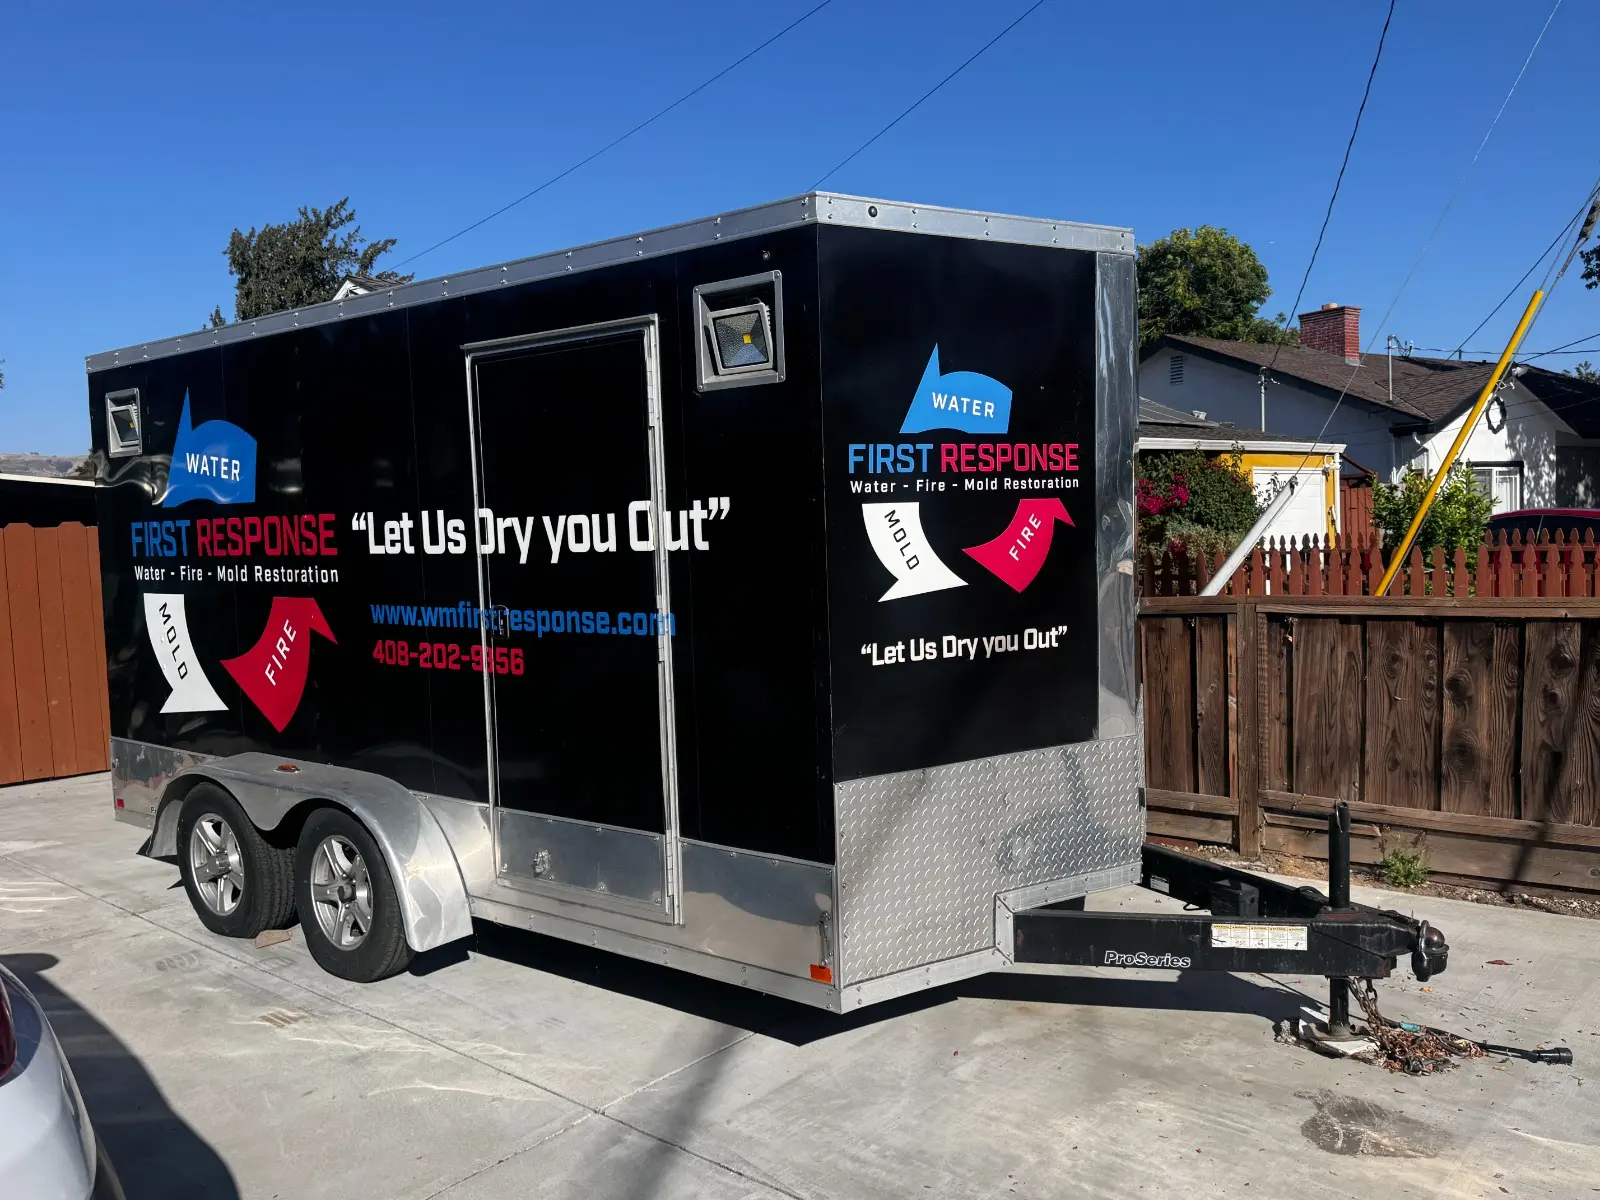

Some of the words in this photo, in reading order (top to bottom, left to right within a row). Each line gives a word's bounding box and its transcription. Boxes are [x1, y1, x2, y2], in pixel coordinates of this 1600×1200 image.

[932, 392, 995, 418] WATER
[186, 452, 241, 482] WATER
[849, 444, 934, 474] FIRST
[941, 443, 1079, 473] RESPONSE
[850, 480, 896, 494] Water
[916, 478, 946, 492] Fire
[964, 477, 998, 491] Mold
[1004, 476, 1079, 490] Restoration
[130, 519, 191, 558] FIRST
[196, 513, 338, 557] RESPONSE
[351, 511, 415, 555] “Let
[421, 509, 467, 555] Us
[476, 507, 535, 565] Dry
[541, 512, 617, 564] you
[627, 496, 731, 552] Out”
[884, 509, 920, 571] MOLD
[1008, 513, 1042, 562] FIRE
[134, 565, 166, 582] Water
[179, 566, 203, 582] Fire
[217, 565, 248, 583] Mold
[254, 565, 339, 584] Restoration
[158, 601, 189, 681] MOLD
[264, 618, 297, 687] FIRE
[860, 641, 906, 666] “Let
[910, 637, 938, 662] Us
[942, 634, 979, 661] Dry
[985, 631, 1019, 659] you
[1023, 625, 1068, 650] Out”
[1103, 950, 1192, 969] ProSeries
